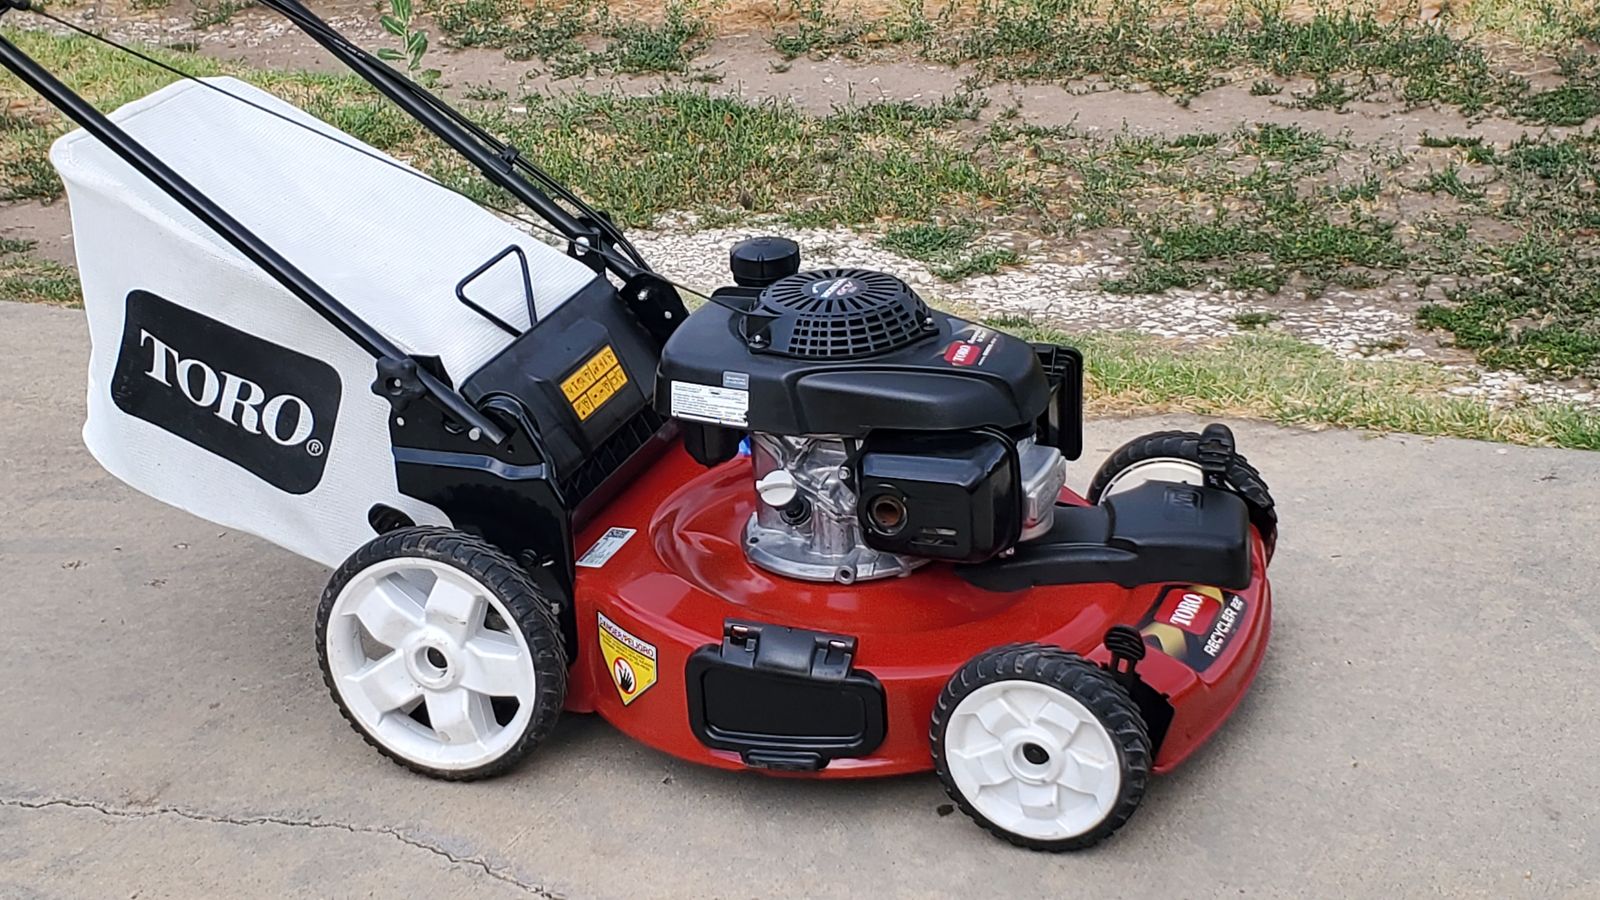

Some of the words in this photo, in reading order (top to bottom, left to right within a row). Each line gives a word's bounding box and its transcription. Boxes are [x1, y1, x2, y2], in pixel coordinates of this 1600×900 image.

[140, 328, 315, 446] TORO
[1169, 593, 1204, 627] TORO
[1203, 607, 1238, 657] RECYCLER
